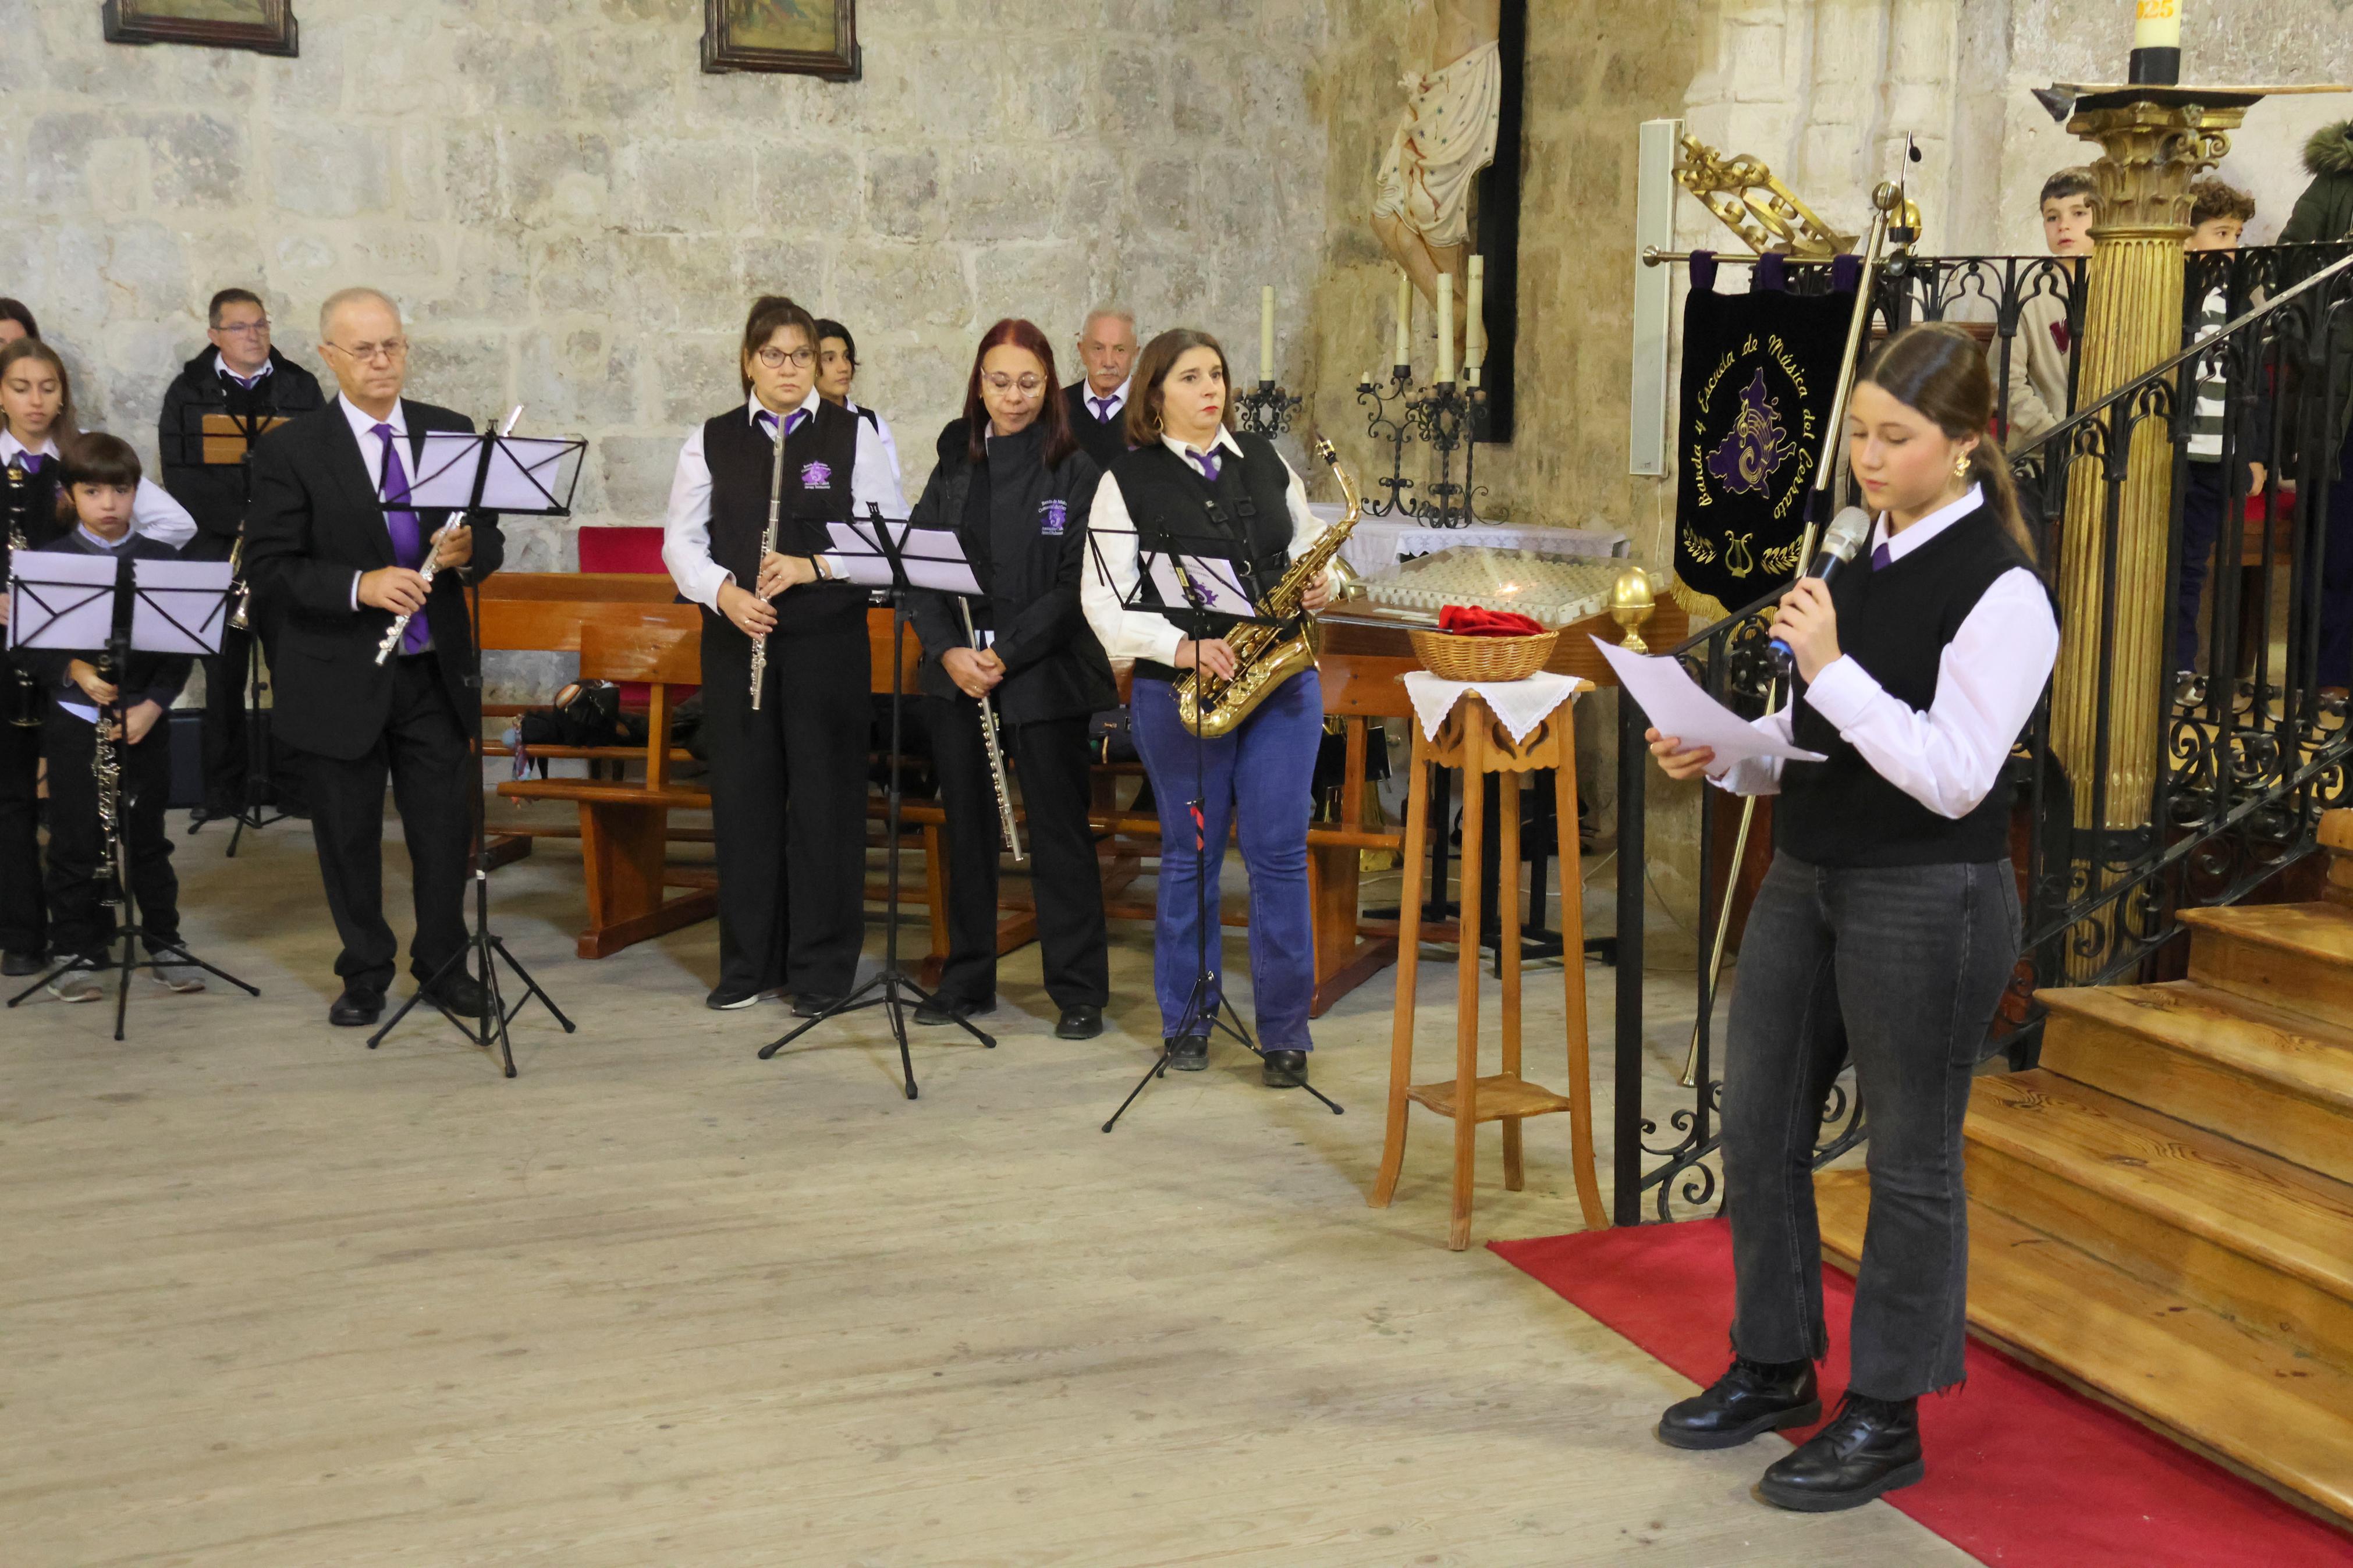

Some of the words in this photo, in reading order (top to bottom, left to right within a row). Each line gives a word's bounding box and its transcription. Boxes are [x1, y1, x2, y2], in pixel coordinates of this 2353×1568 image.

[1741, 333, 1758, 356] de
[1768, 334, 1808, 399] Música
[1698, 351, 1736, 414] Escuela
[1695, 419, 1706, 435] y
[1803, 408, 1816, 439] del
[1691, 444, 1713, 507] Banda
[1774, 447, 1813, 519] Cerrato
